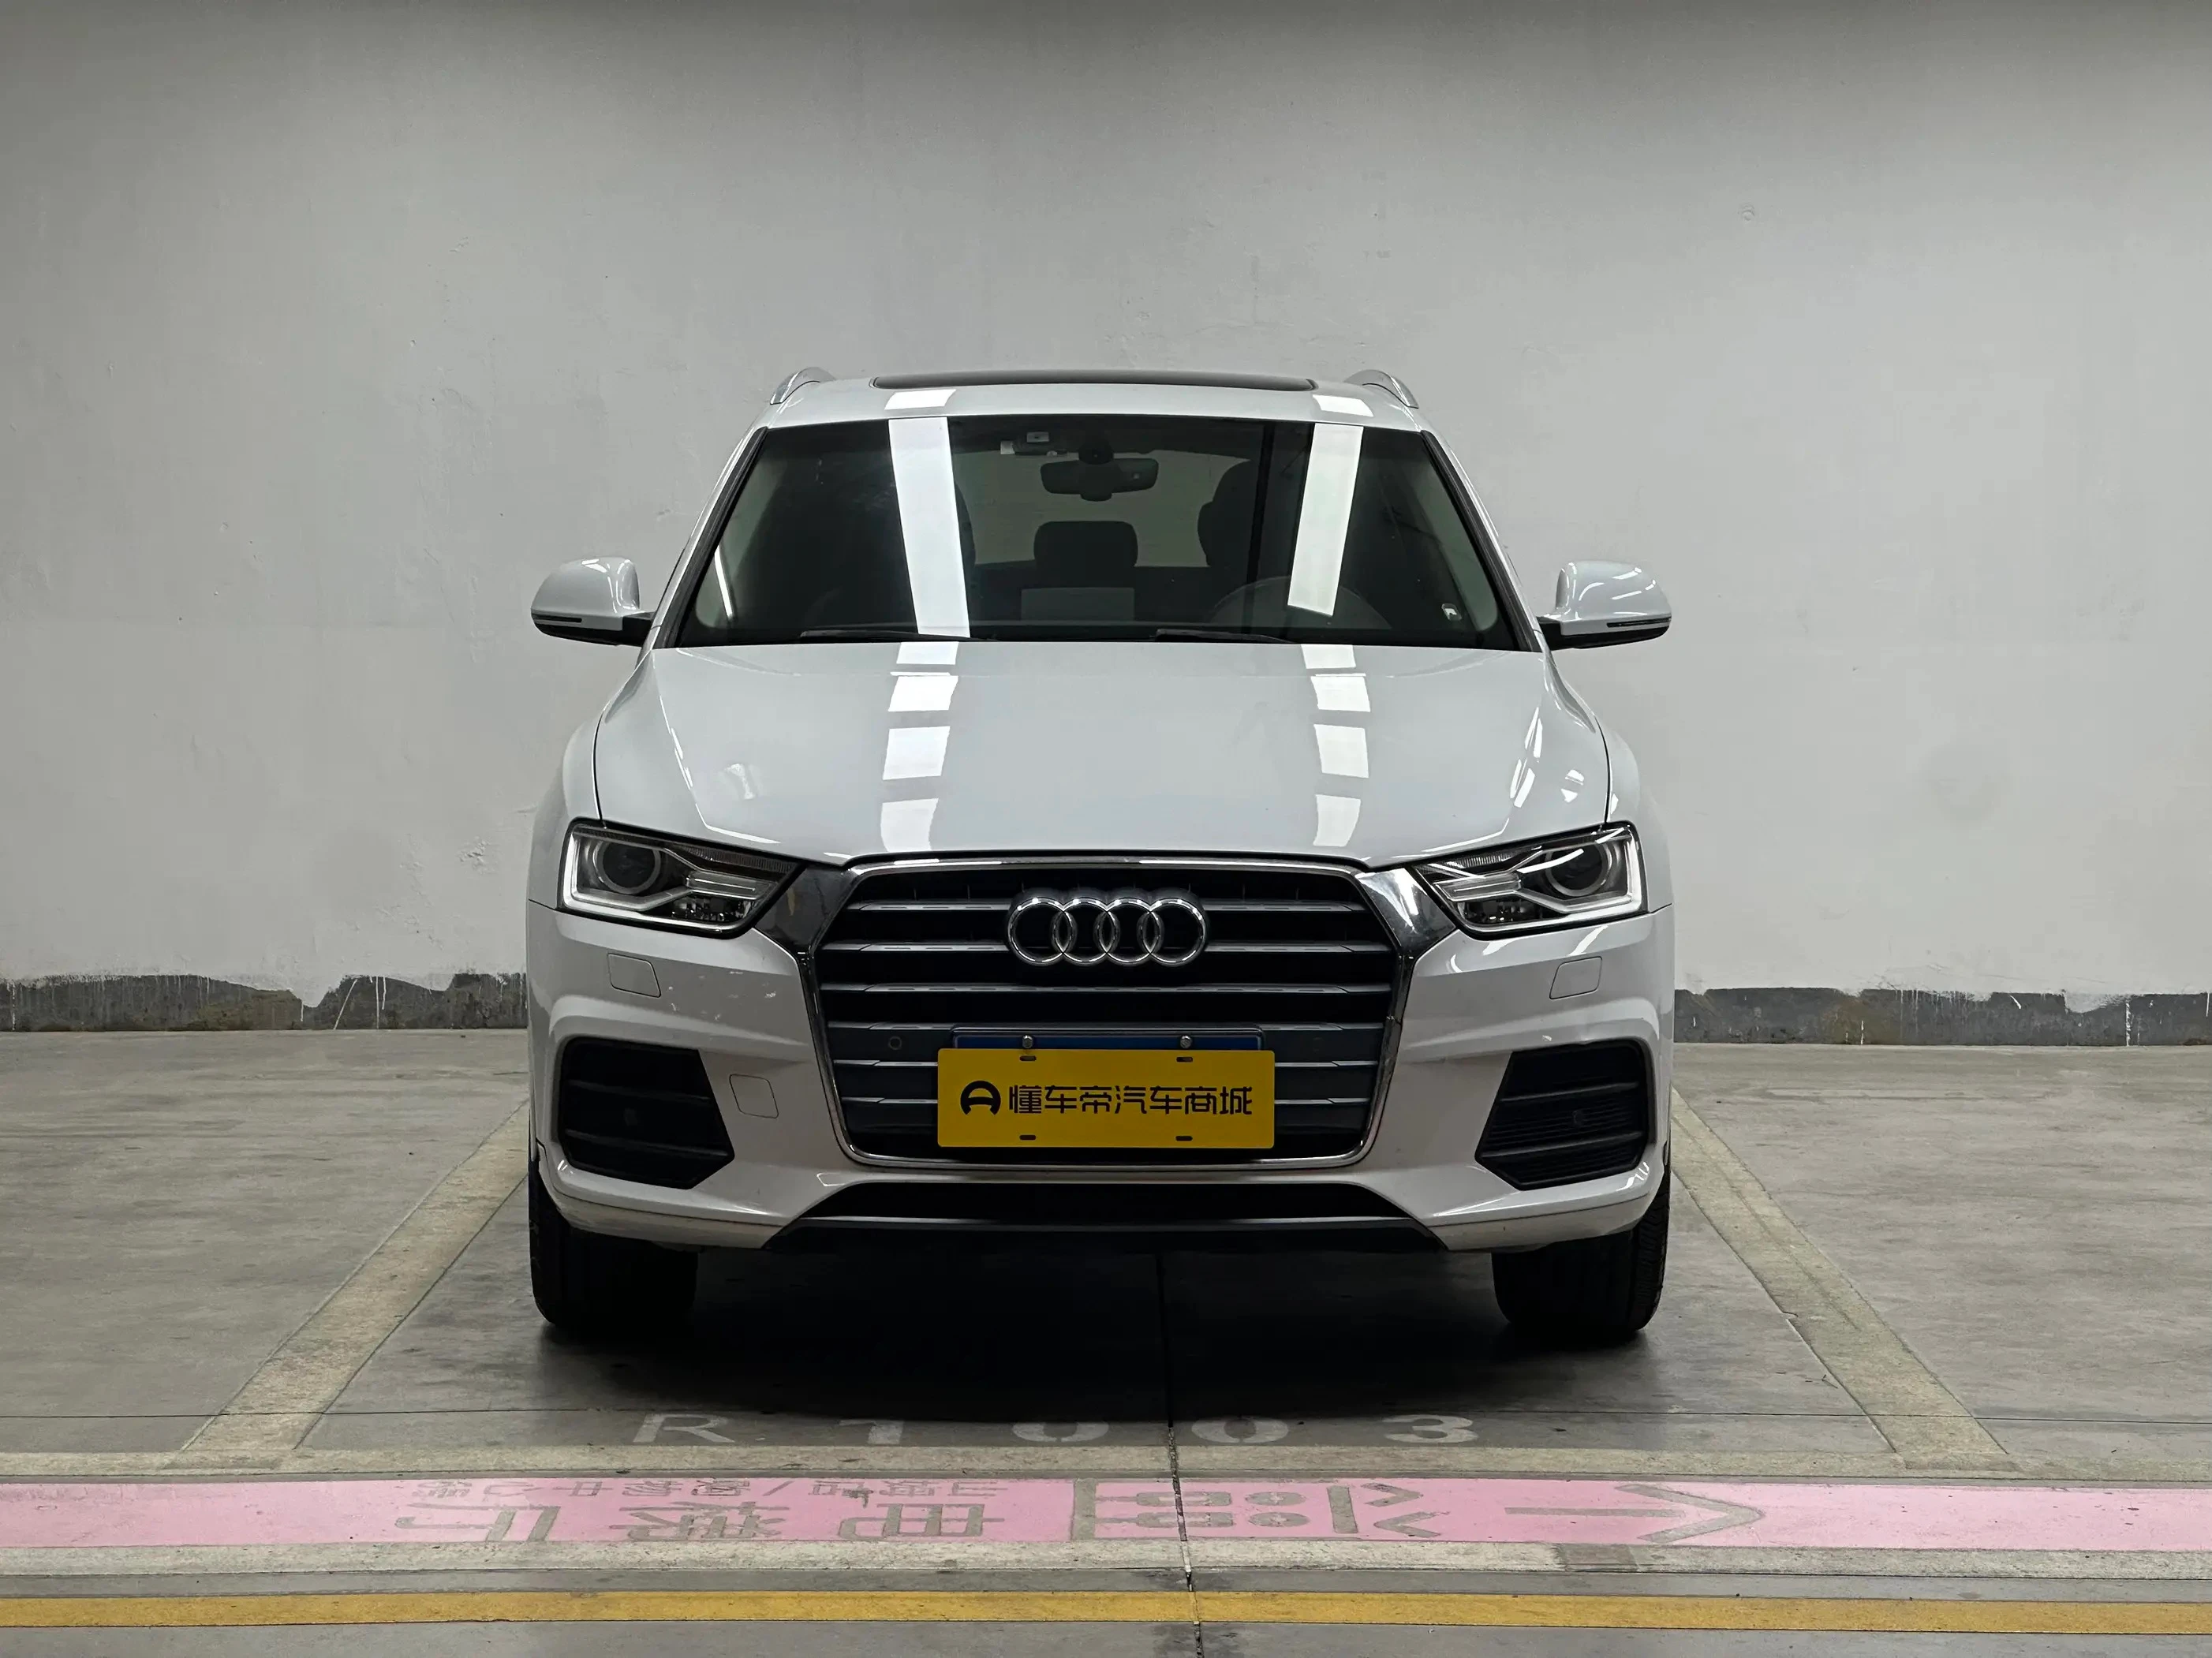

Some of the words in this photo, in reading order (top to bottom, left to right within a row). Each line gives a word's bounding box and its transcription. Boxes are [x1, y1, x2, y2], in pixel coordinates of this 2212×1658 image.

[1008, 1085, 1253, 1115] 懂车帝汽车商城
